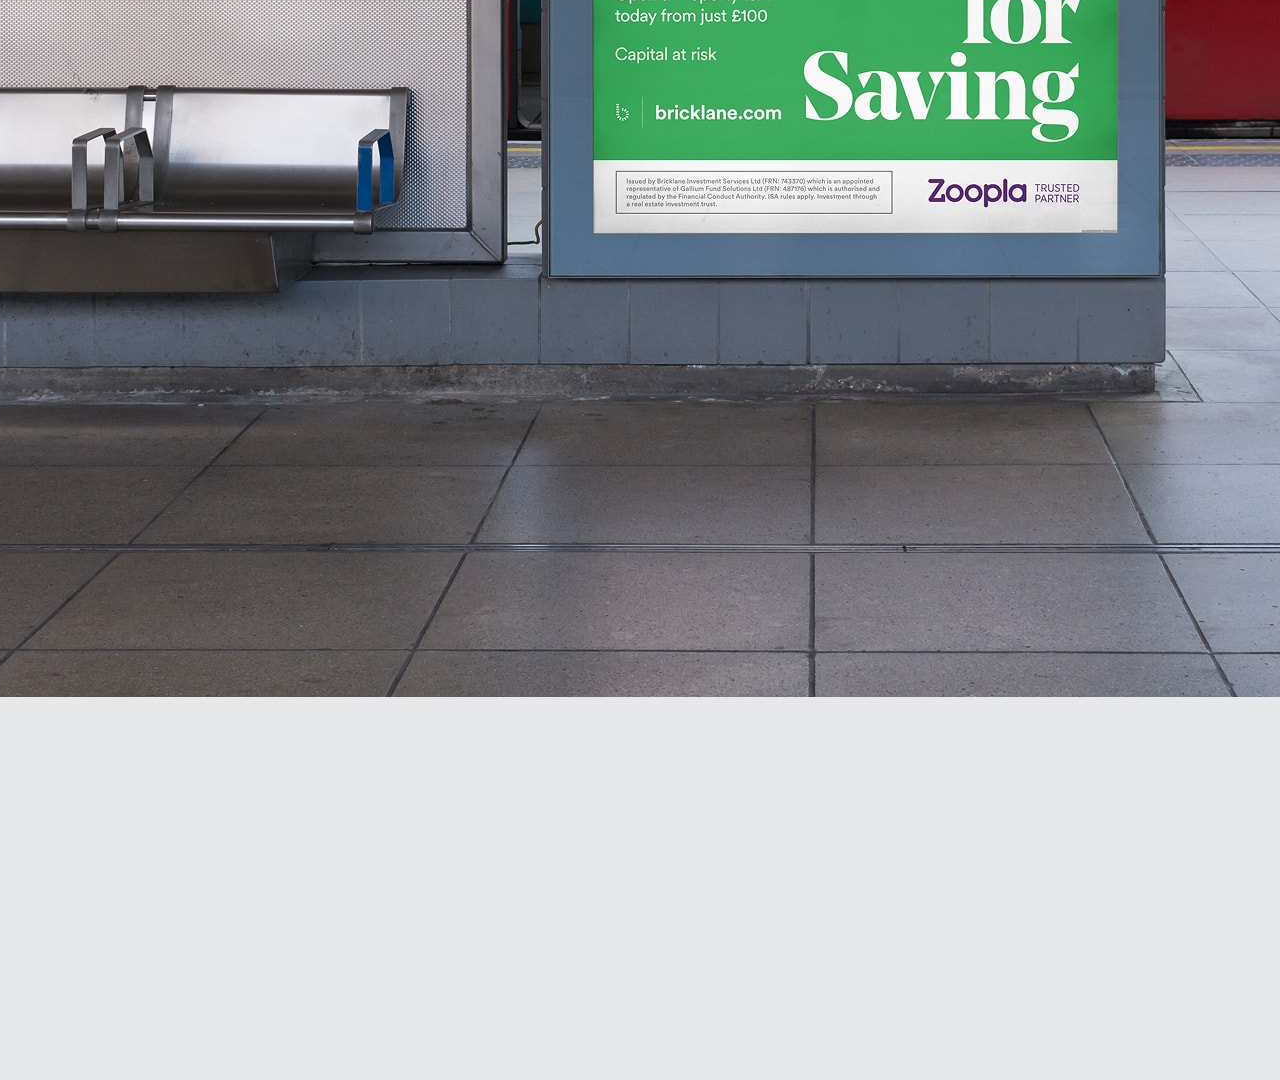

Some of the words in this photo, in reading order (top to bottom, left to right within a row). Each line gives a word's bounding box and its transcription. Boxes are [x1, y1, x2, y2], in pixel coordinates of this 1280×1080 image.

[615, 8, 658, 26] today
[660, 8, 697, 23] from
[699, 8, 727, 26] just
[731, 9, 768, 23] £100
[615, 47, 668, 64] Capital
[672, 48, 687, 61] at
[691, 46, 717, 61] risk
[804, 51, 1078, 142] Saving
[655, 104, 782, 120] bricklane.com
[927, 178, 1028, 208] Zoopla
[1034, 183, 1080, 193] TRUSTED
[1034, 193, 1080, 204] PARTNER
